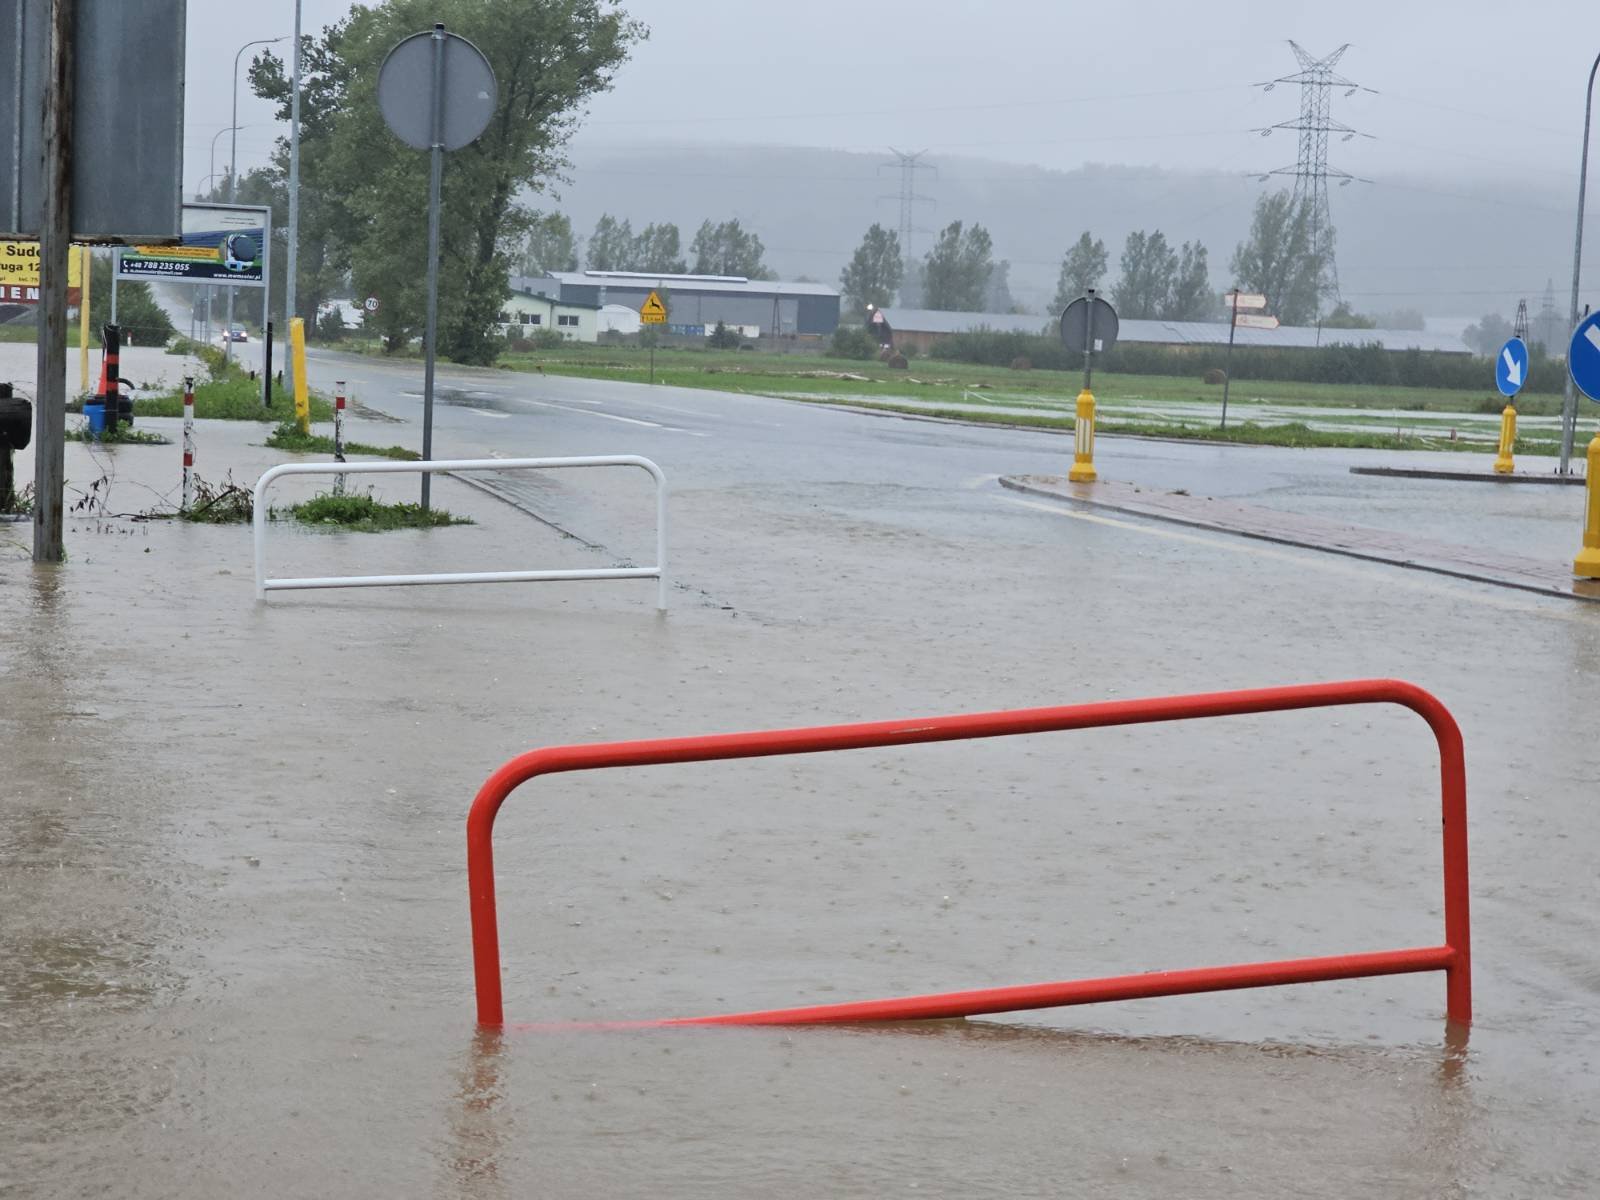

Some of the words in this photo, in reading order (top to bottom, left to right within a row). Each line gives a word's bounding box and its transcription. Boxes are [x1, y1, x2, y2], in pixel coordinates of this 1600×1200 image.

[0, 263, 24, 273] uga
[143, 261, 159, 269] 788
[174, 263, 190, 271] 055
[367, 299, 378, 308] 70
